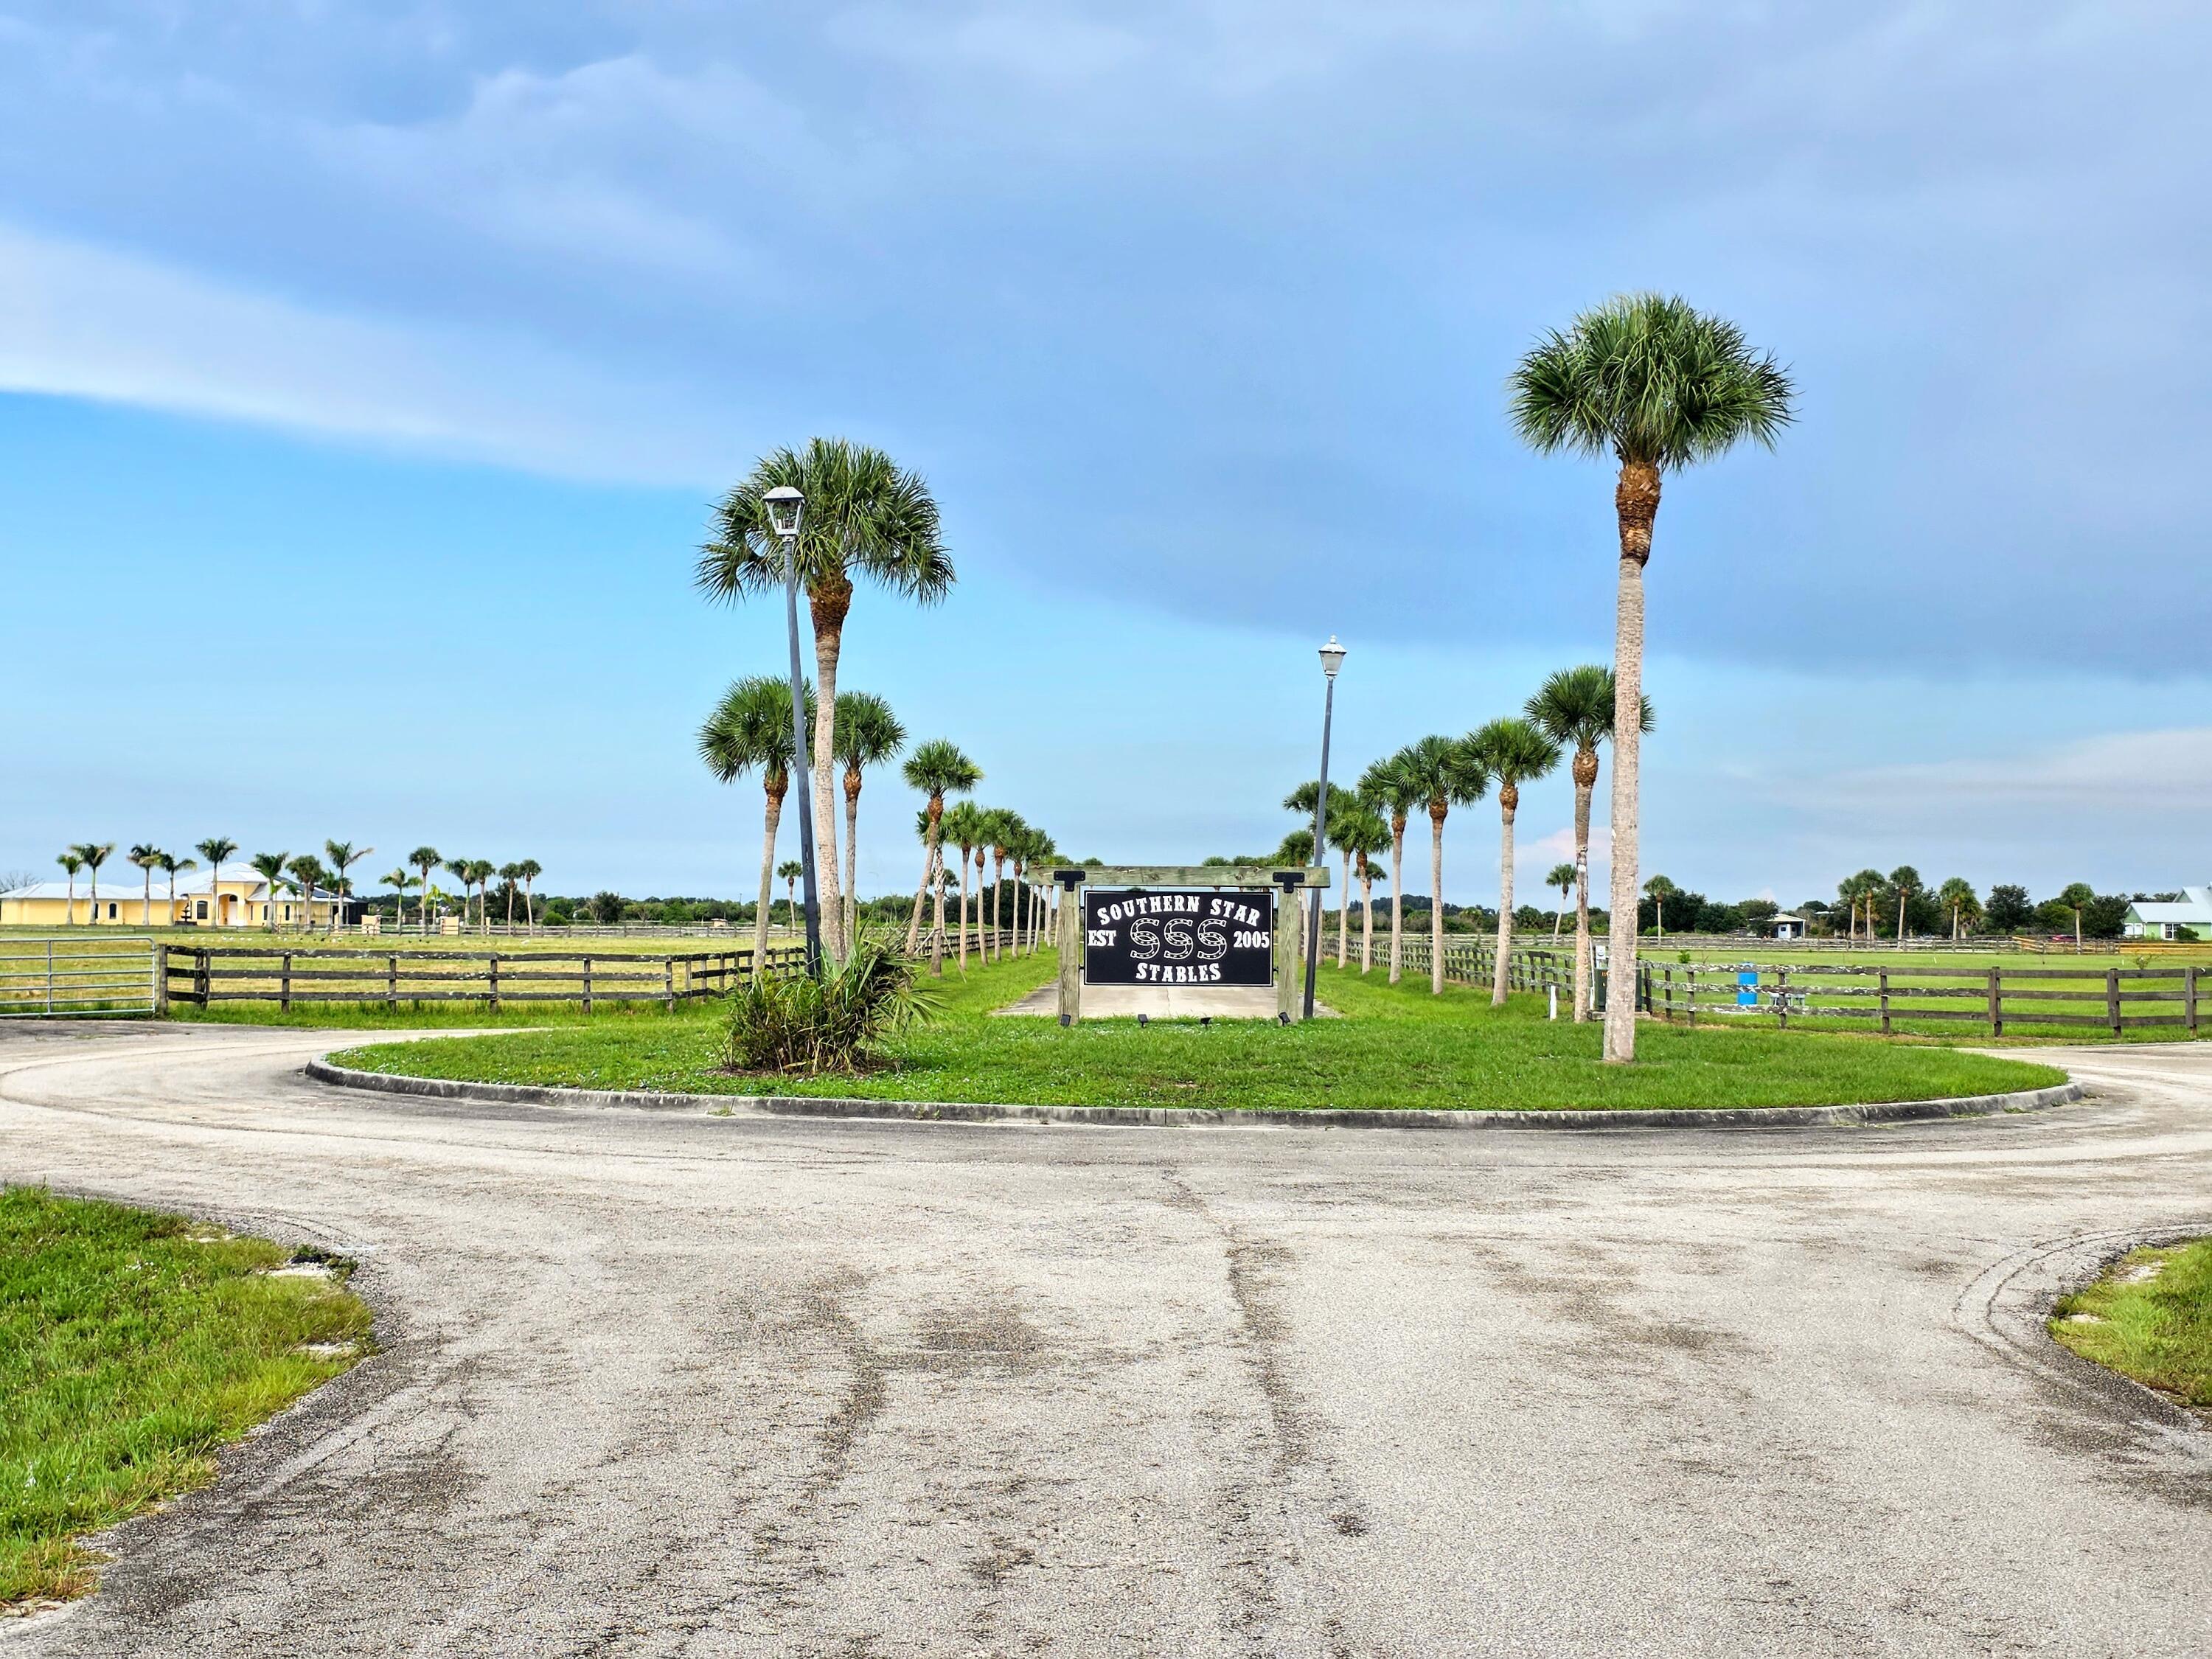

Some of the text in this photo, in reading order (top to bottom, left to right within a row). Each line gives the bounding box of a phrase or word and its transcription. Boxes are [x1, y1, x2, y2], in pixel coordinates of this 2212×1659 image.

[1097, 895, 1260, 926] SOUTHERN STAR
[1088, 930, 1116, 947] EST
[1233, 931, 1270, 948] 2005
[1135, 963, 1221, 982] STABLES
